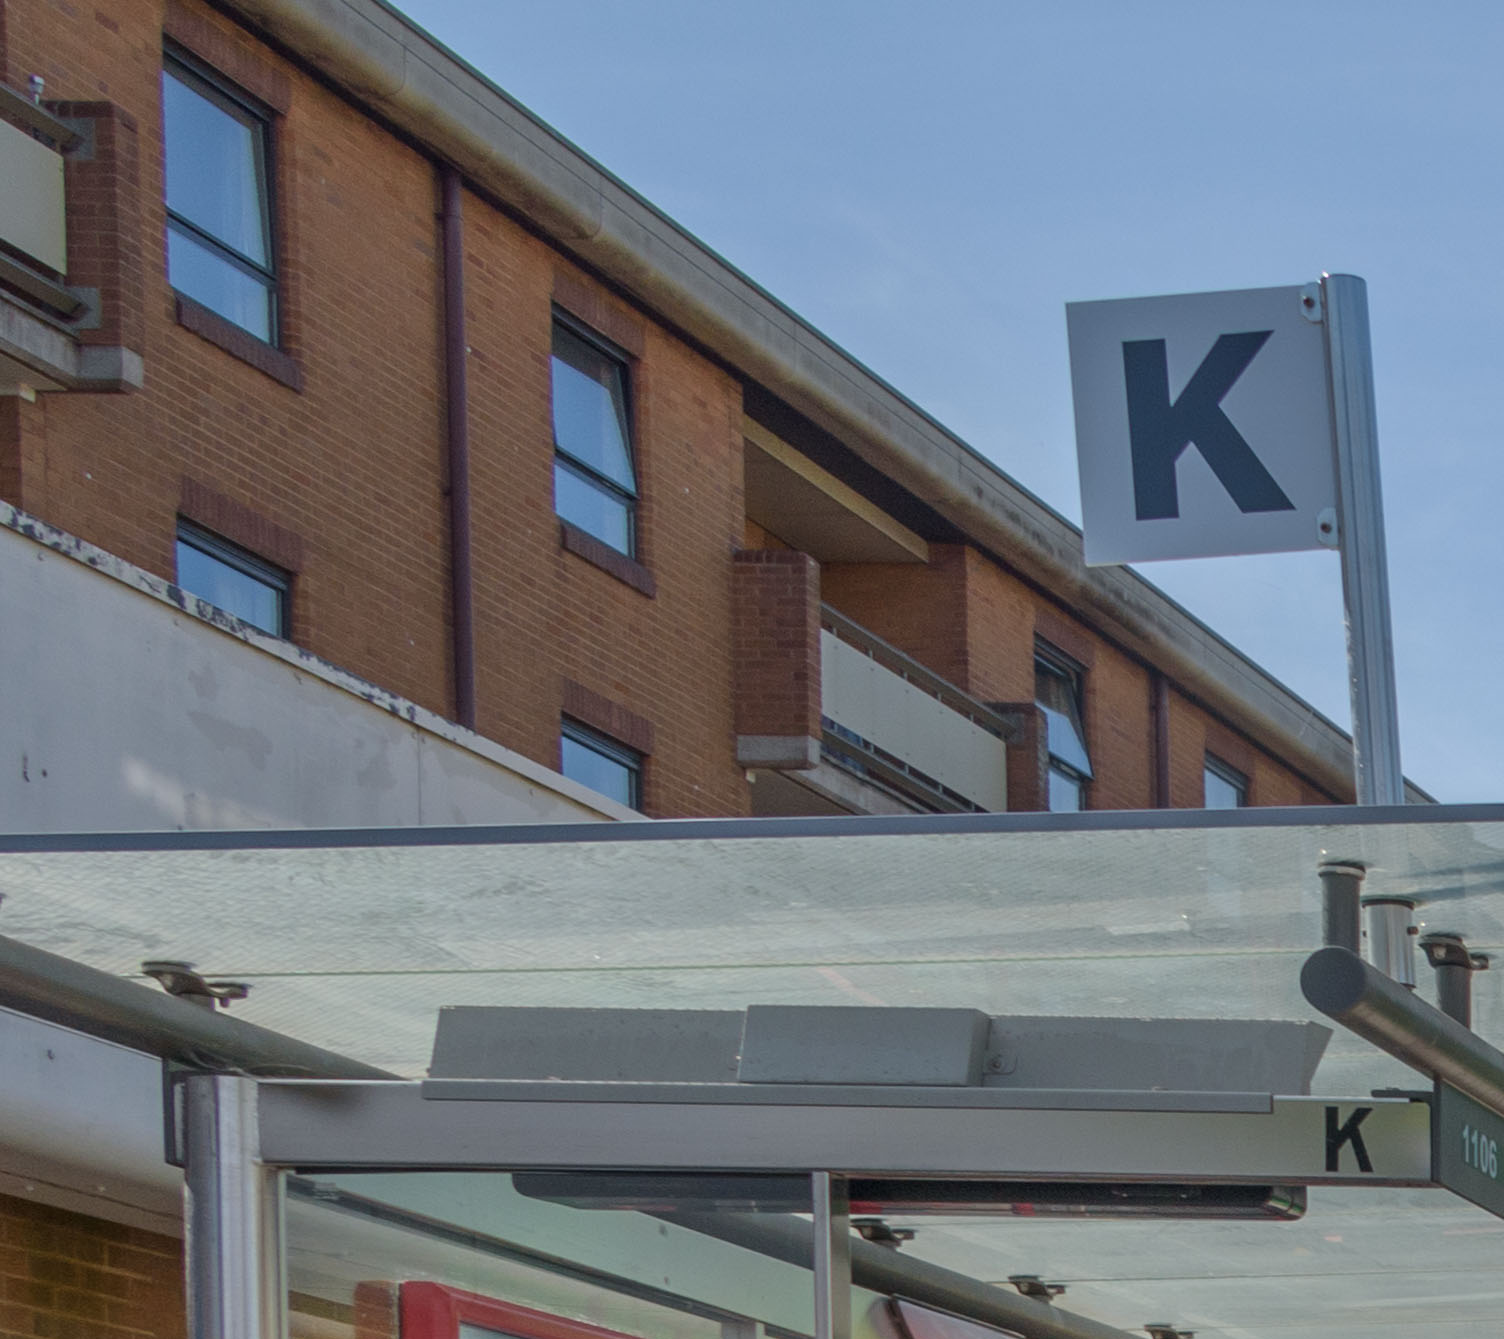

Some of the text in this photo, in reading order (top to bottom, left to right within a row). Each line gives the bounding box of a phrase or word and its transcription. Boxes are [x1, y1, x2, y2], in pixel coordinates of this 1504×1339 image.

[1122, 329, 1296, 522] K
[1324, 1105, 1374, 1173] K
[1463, 1124, 1497, 1178] 1106
